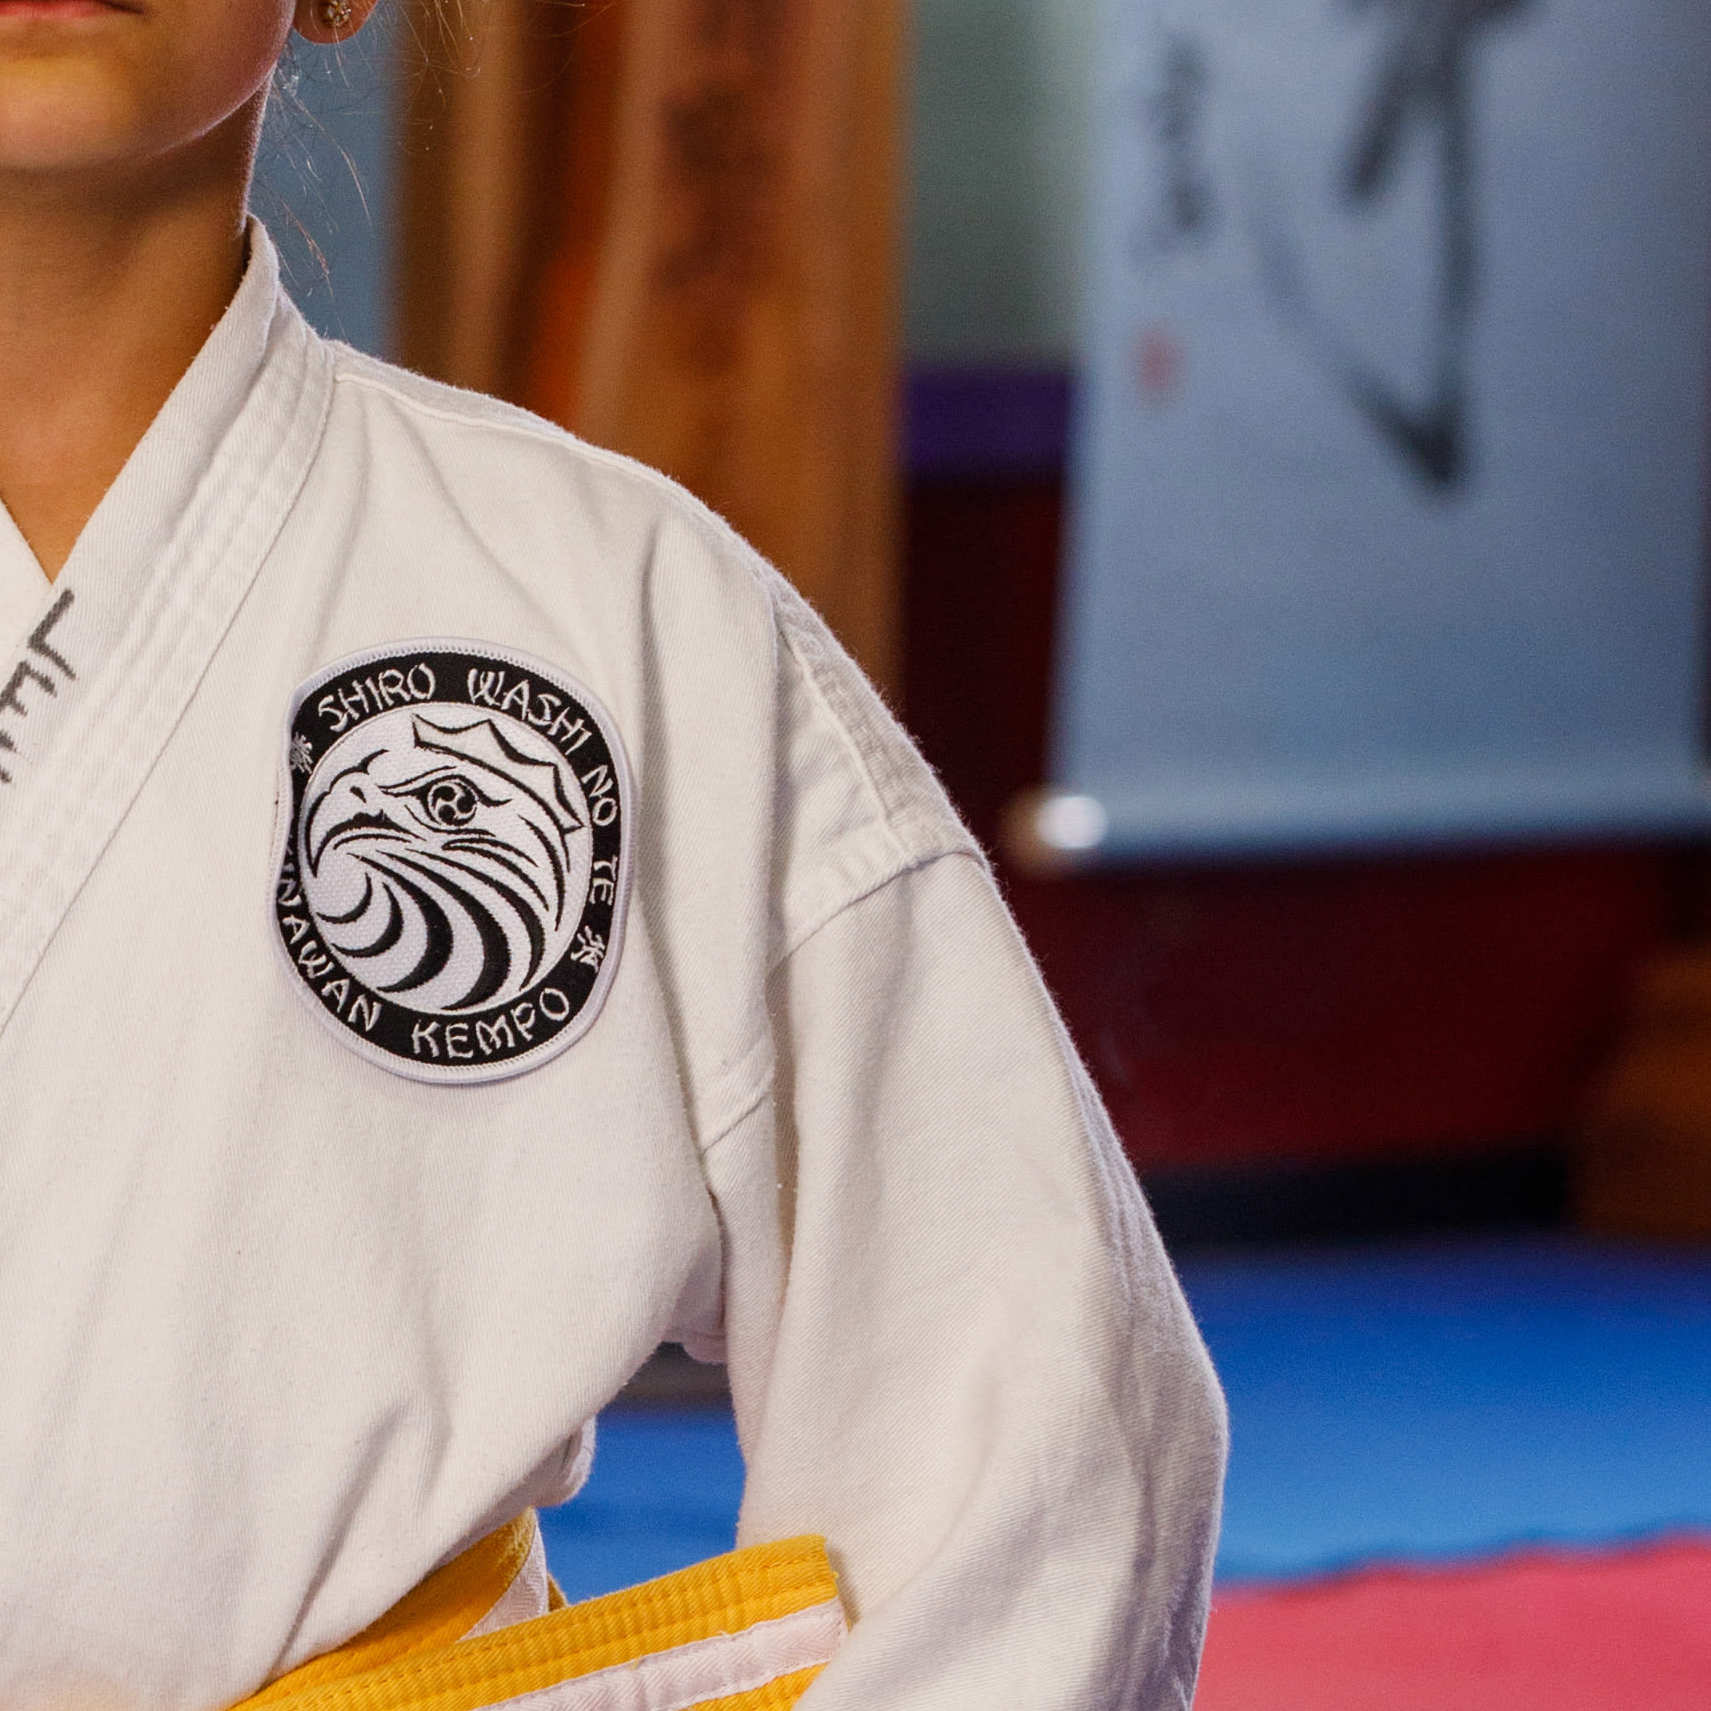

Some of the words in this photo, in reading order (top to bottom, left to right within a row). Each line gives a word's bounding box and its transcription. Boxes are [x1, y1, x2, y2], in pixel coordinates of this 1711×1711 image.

[317, 662, 436, 733] SHIRO
[467, 667, 592, 756] WASHI
[581, 764, 618, 827] NO
[588, 855, 620, 907] TE
[410, 988, 570, 1059] KEMPO
